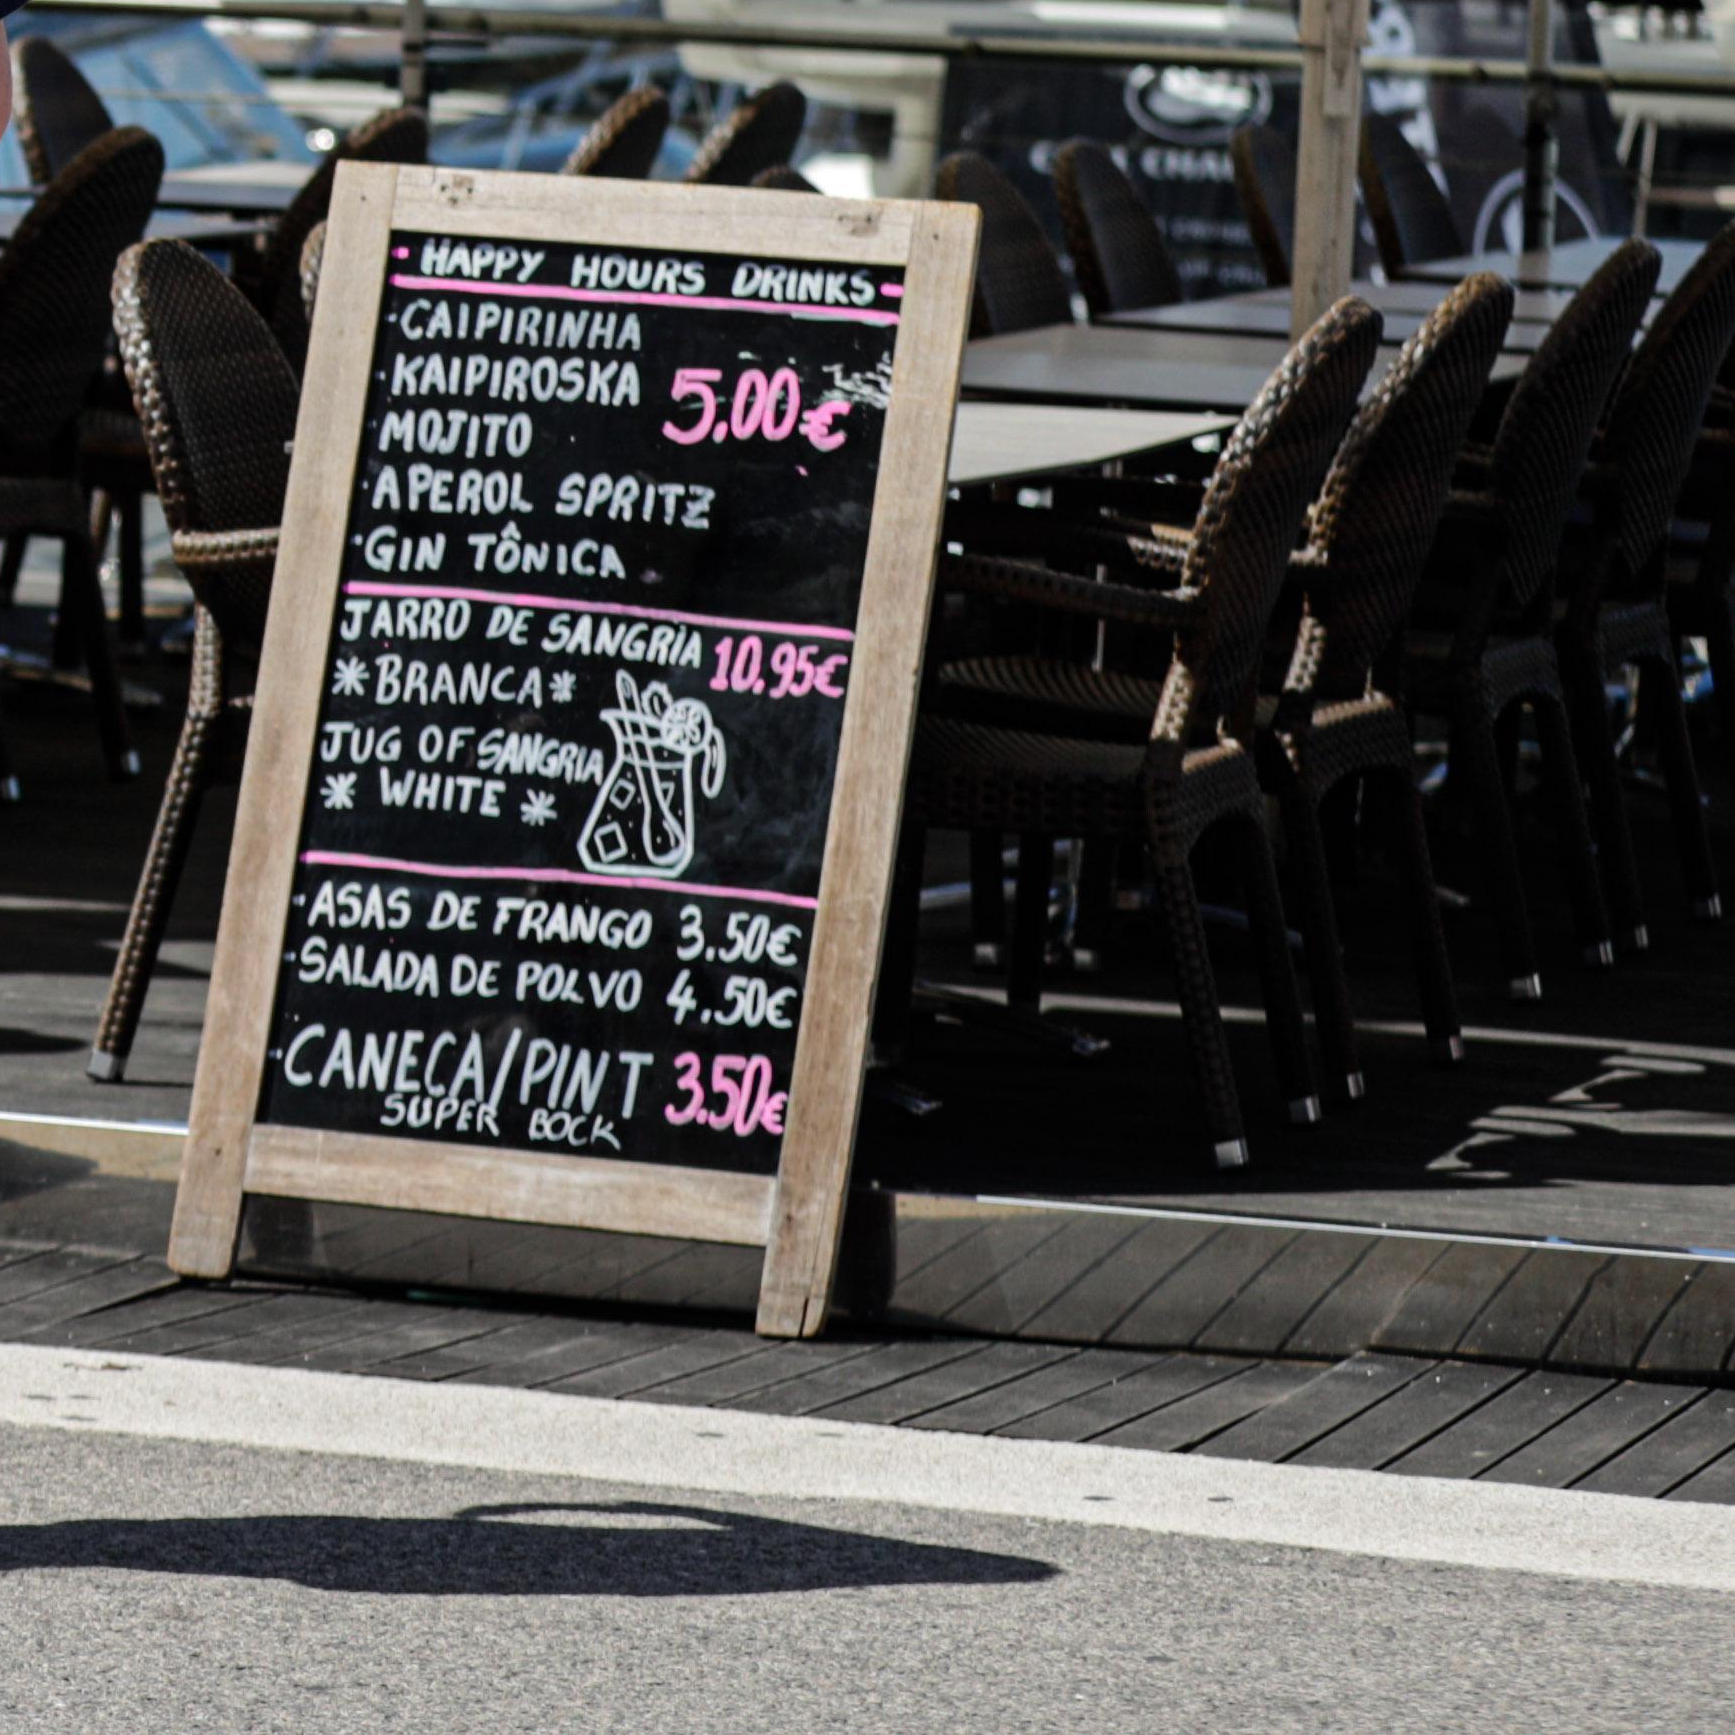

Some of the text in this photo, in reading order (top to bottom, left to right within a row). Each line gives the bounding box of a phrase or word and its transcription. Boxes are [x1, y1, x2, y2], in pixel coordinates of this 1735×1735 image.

[419, 237, 877, 307] HAPPY HOURS DRINKS
[400, 296, 643, 351] CAIPIRINHA
[378, 408, 533, 459] MOJITO
[391, 352, 853, 453] KAIPIROSKA 5.00€
[371, 463, 716, 529] APEROL SPRITZ
[360, 525, 446, 572] GIN
[340, 596, 474, 641] JARRO
[485, 603, 538, 646] DE
[320, 721, 605, 786] JUG OF SANGRIA
[307, 880, 412, 930] ASAS
[426, 890, 479, 931] DE
[492, 897, 653, 949] FRANGO
[298, 935, 439, 998] SALADA
[450, 954, 501, 998] DE
[515, 960, 643, 1012] POLVO
[379, 1091, 621, 1153] SUPER BOCK
